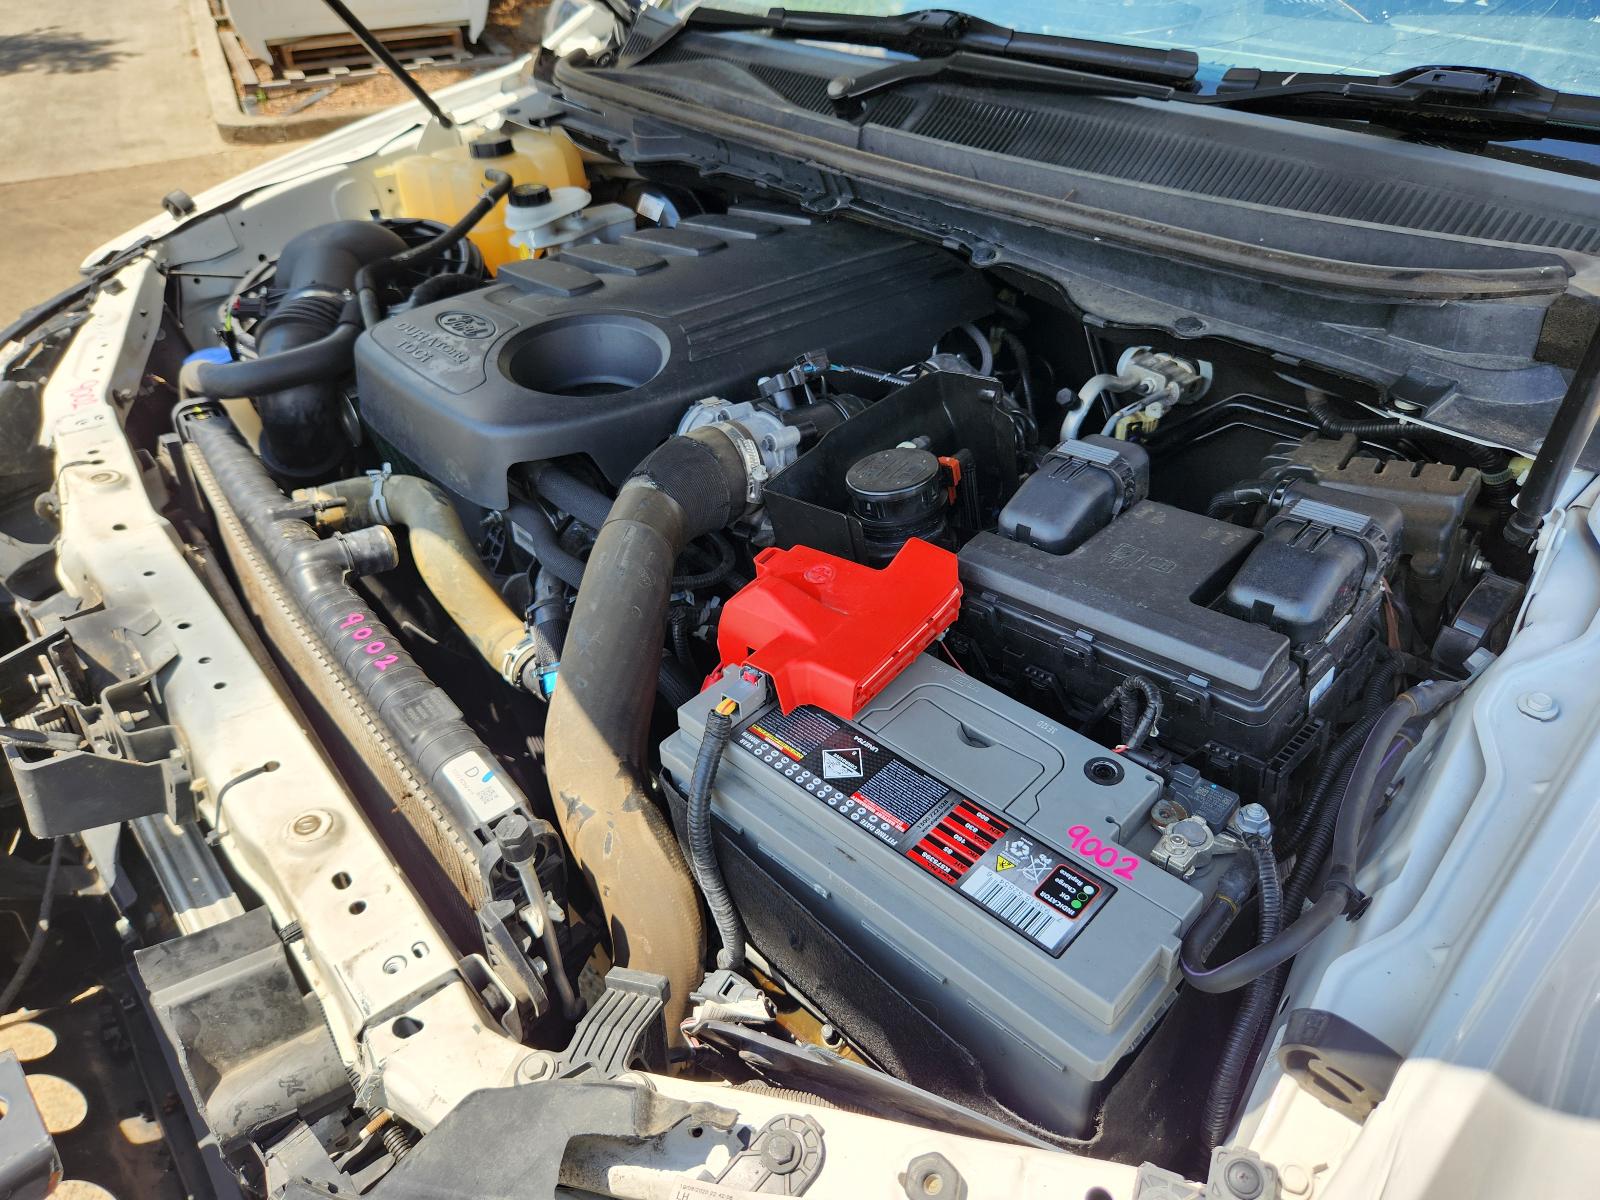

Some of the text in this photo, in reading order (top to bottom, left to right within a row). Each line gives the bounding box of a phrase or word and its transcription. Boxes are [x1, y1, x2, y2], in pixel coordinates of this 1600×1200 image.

[443, 315, 488, 337] Ford
[339, 611, 399, 672] 9002
[853, 735, 879, 753] UN2794
[860, 819, 898, 845] FITTING DATE
[973, 836, 988, 846] CCA
[1067, 824, 1141, 881] 9002
[1053, 877, 1078, 894] Charge
[1059, 869, 1084, 886] Replace
[1039, 891, 1075, 915] INDICATOR
[1059, 892, 1071, 900] OK
